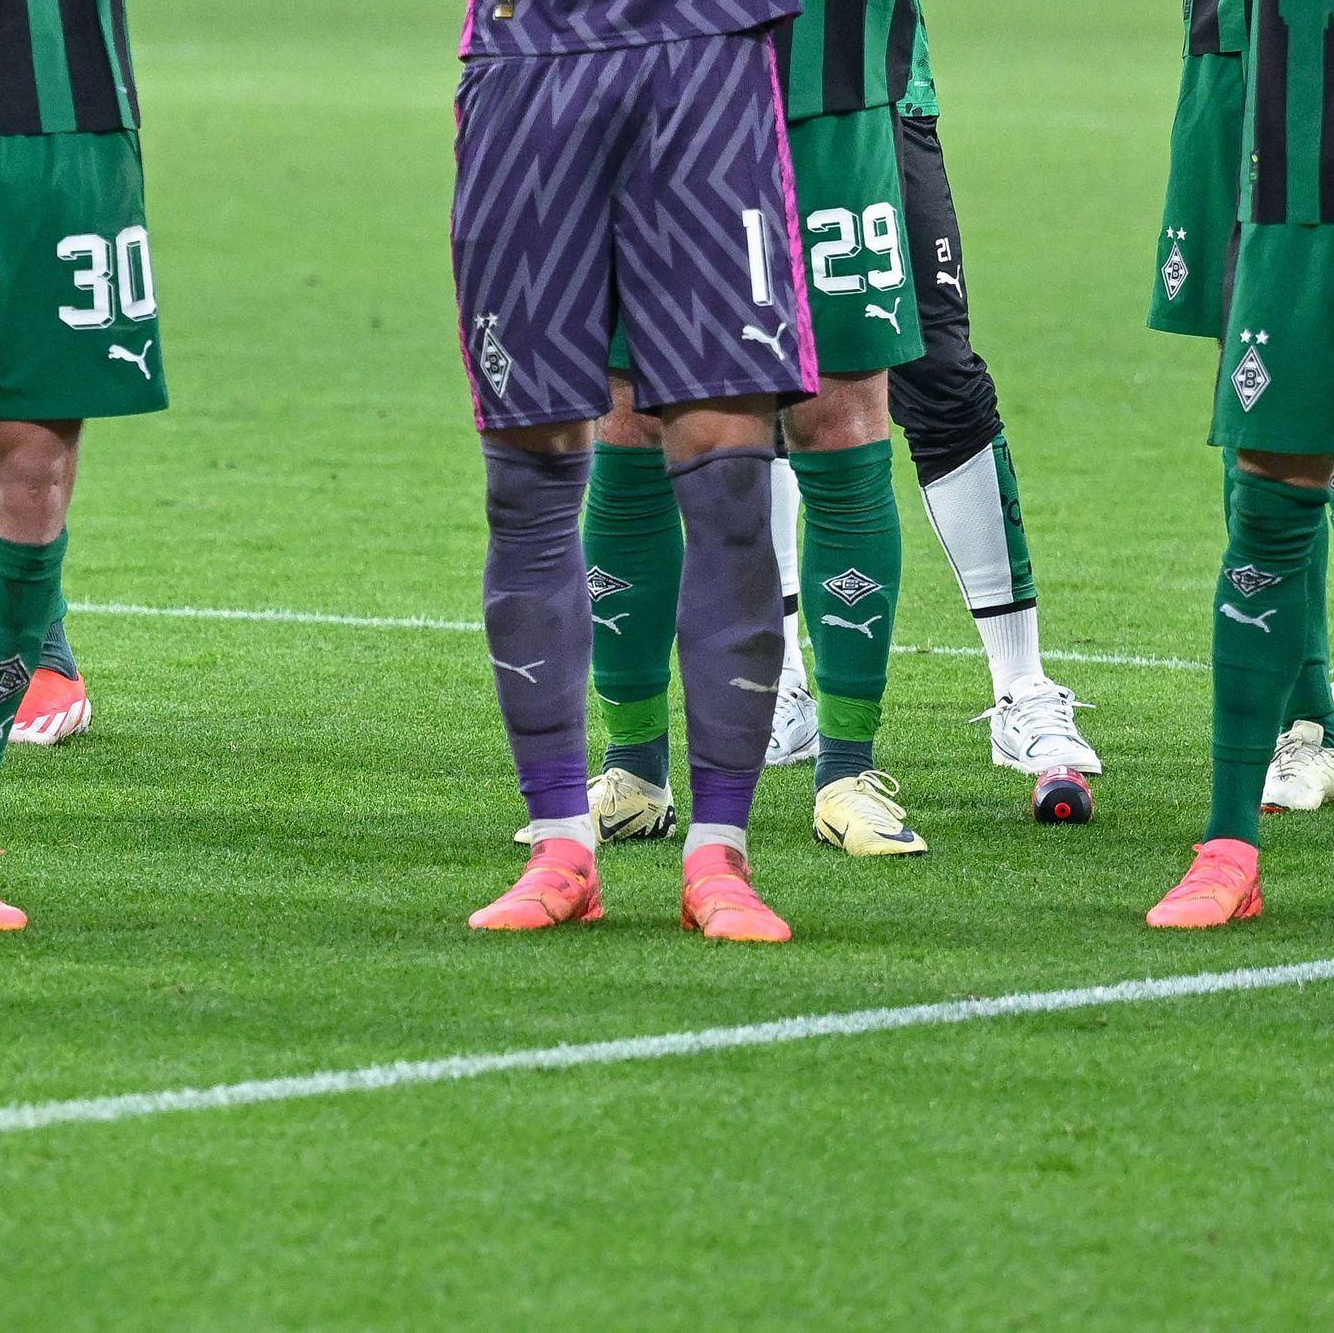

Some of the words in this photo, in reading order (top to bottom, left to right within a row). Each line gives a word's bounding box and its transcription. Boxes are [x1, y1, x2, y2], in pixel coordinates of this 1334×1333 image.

[56, 224, 157, 331] 30
[741, 209, 773, 307] 1
[806, 201, 906, 296] 29
[935, 237, 952, 263] 21
